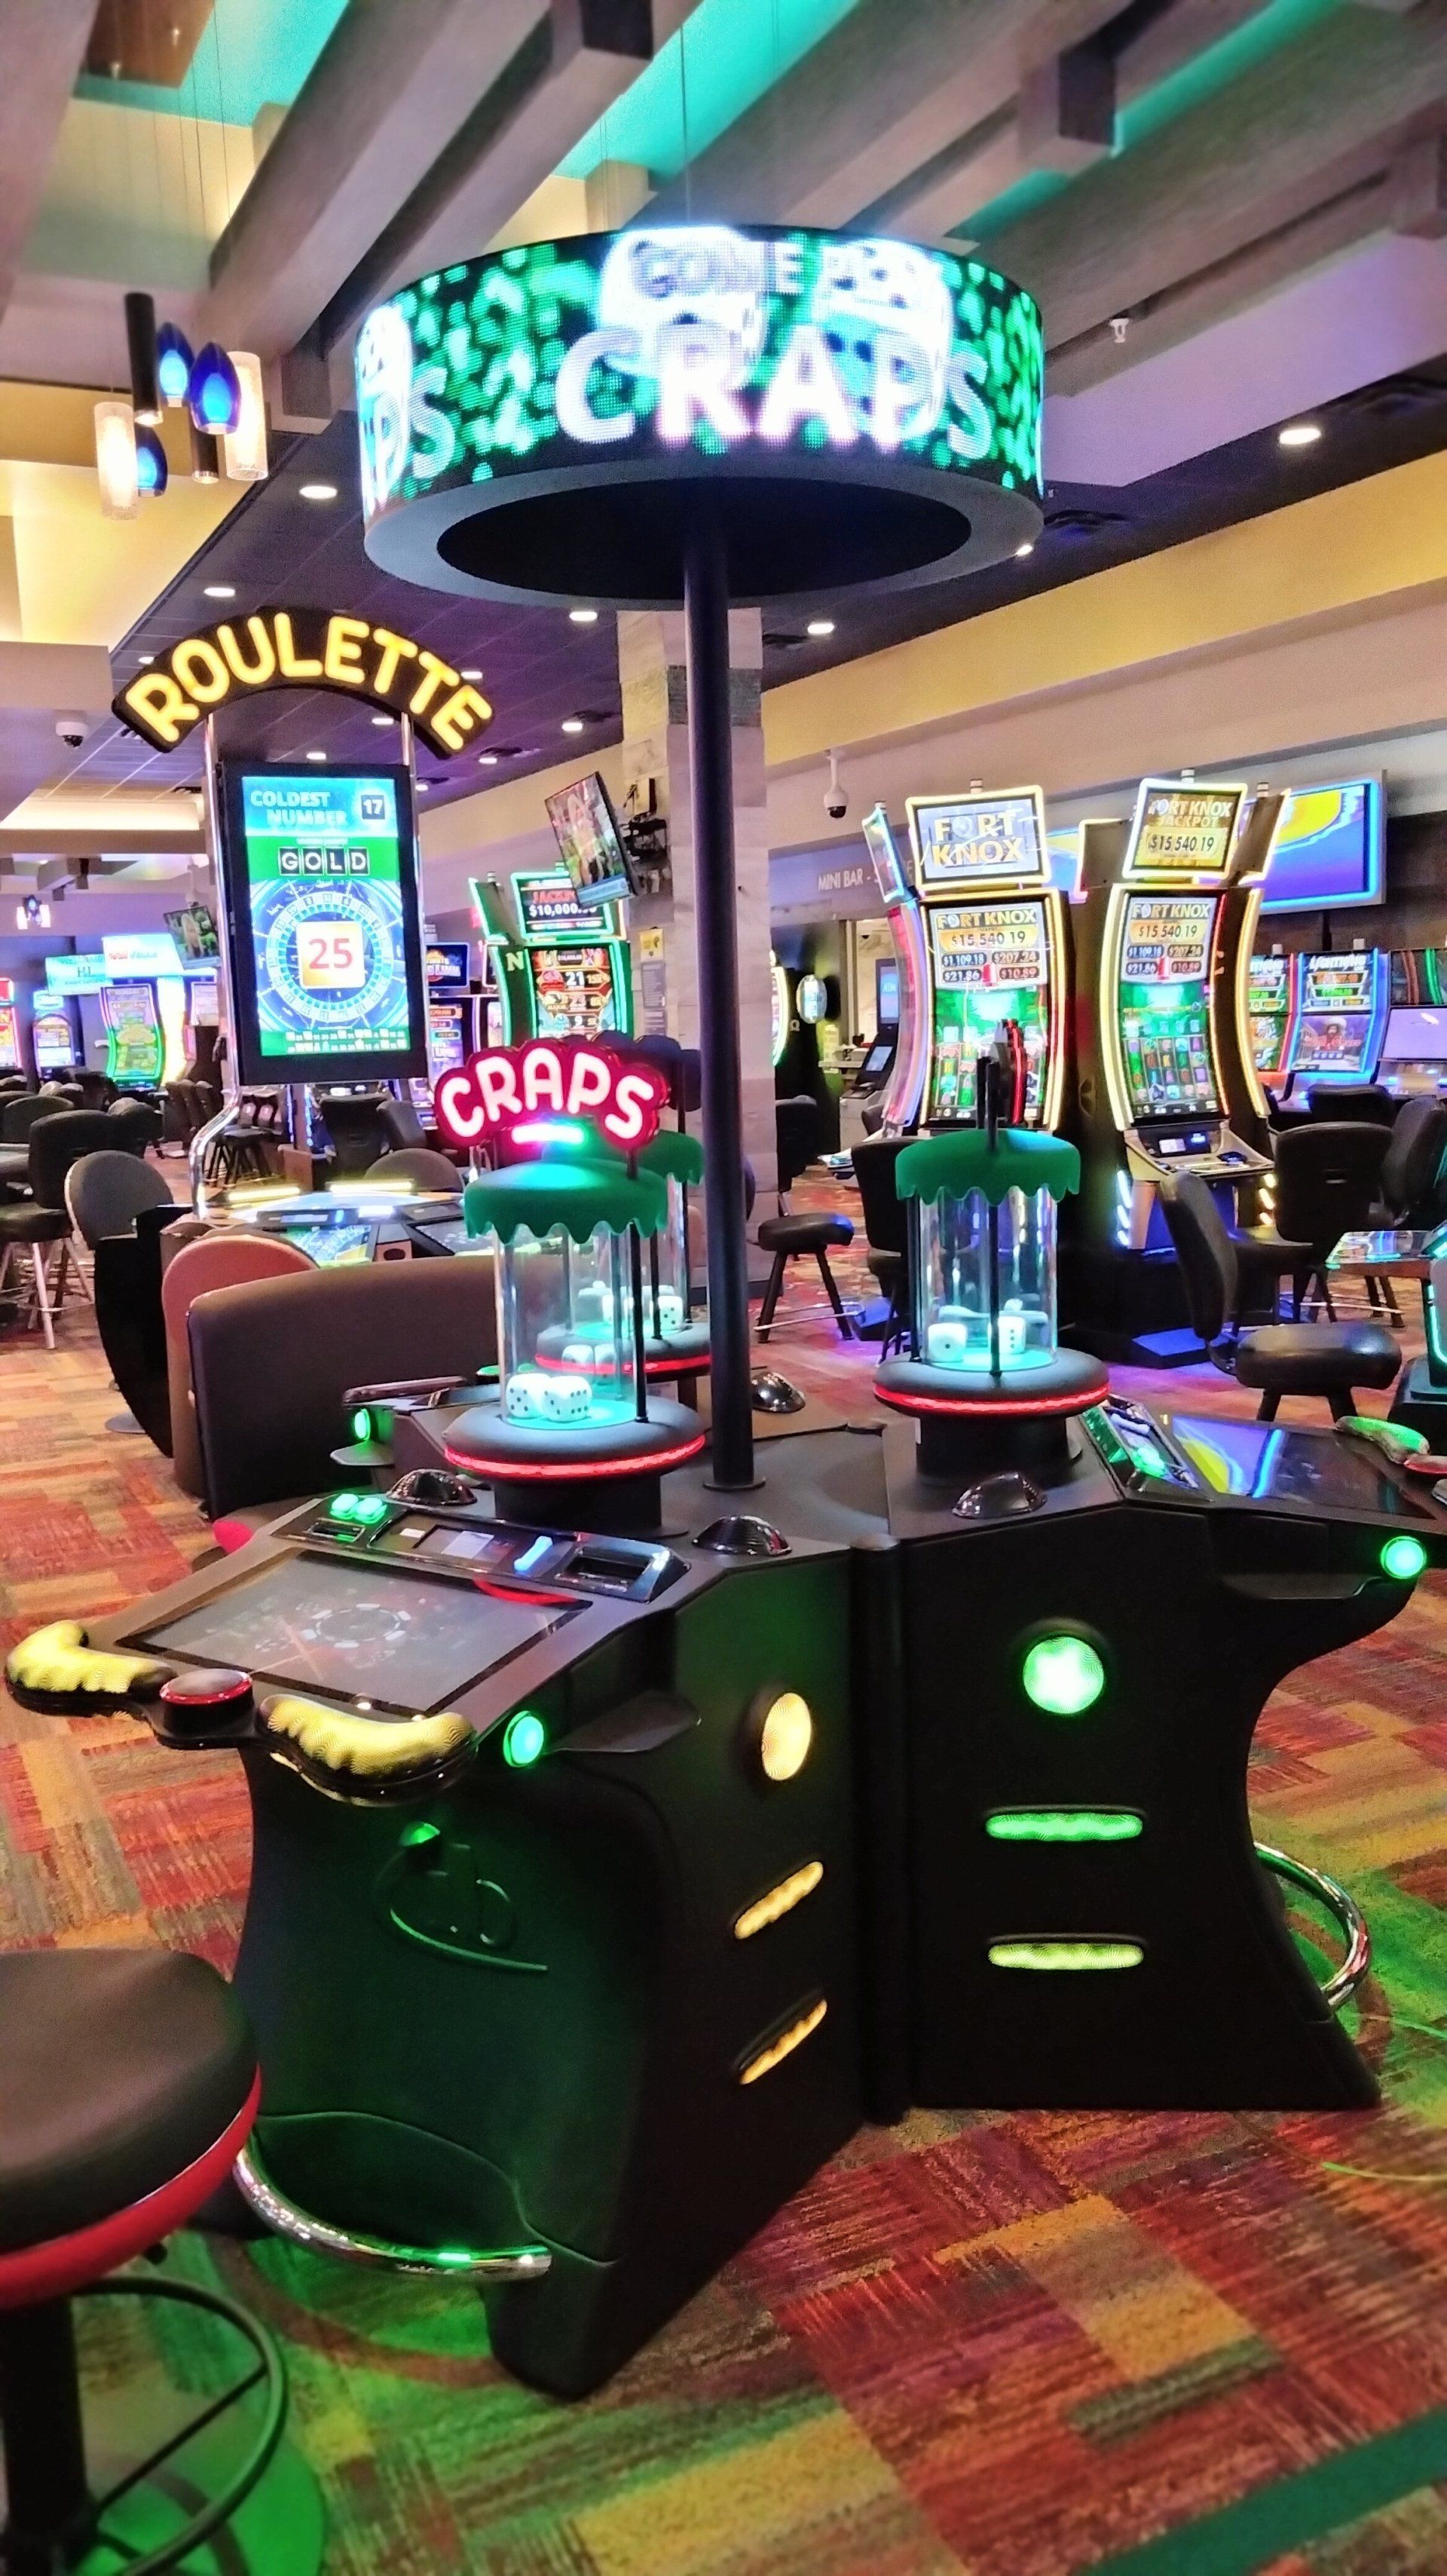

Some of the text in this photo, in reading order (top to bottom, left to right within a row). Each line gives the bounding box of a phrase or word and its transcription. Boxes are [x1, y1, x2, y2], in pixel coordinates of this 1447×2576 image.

[554, 324, 993, 460] CRAPS
[125, 612, 493, 750] ROULETTE
[250, 791, 330, 807] COLDEST
[363, 799, 382, 814] 17
[267, 809, 347, 826] NUMBER
[1188, 801, 1233, 817] KNOX
[935, 812, 1016, 842] FORT
[1156, 815, 1219, 827] JACKPOT
[932, 836, 1023, 866] KNOX
[282, 852, 366, 870] GOLD
[818, 872, 841, 891] MINI
[843, 868, 864, 888] BAR
[533, 890, 576, 904] JACKP
[529, 903, 597, 917] $10,000.
[1131, 904, 1210, 918] FORT KNOX
[938, 909, 1036, 930] FORT KNOX
[308, 938, 353, 970] 25
[506, 951, 525, 971] N
[565, 971, 585, 986] 21
[441, 1047, 654, 1139] CRAPS
